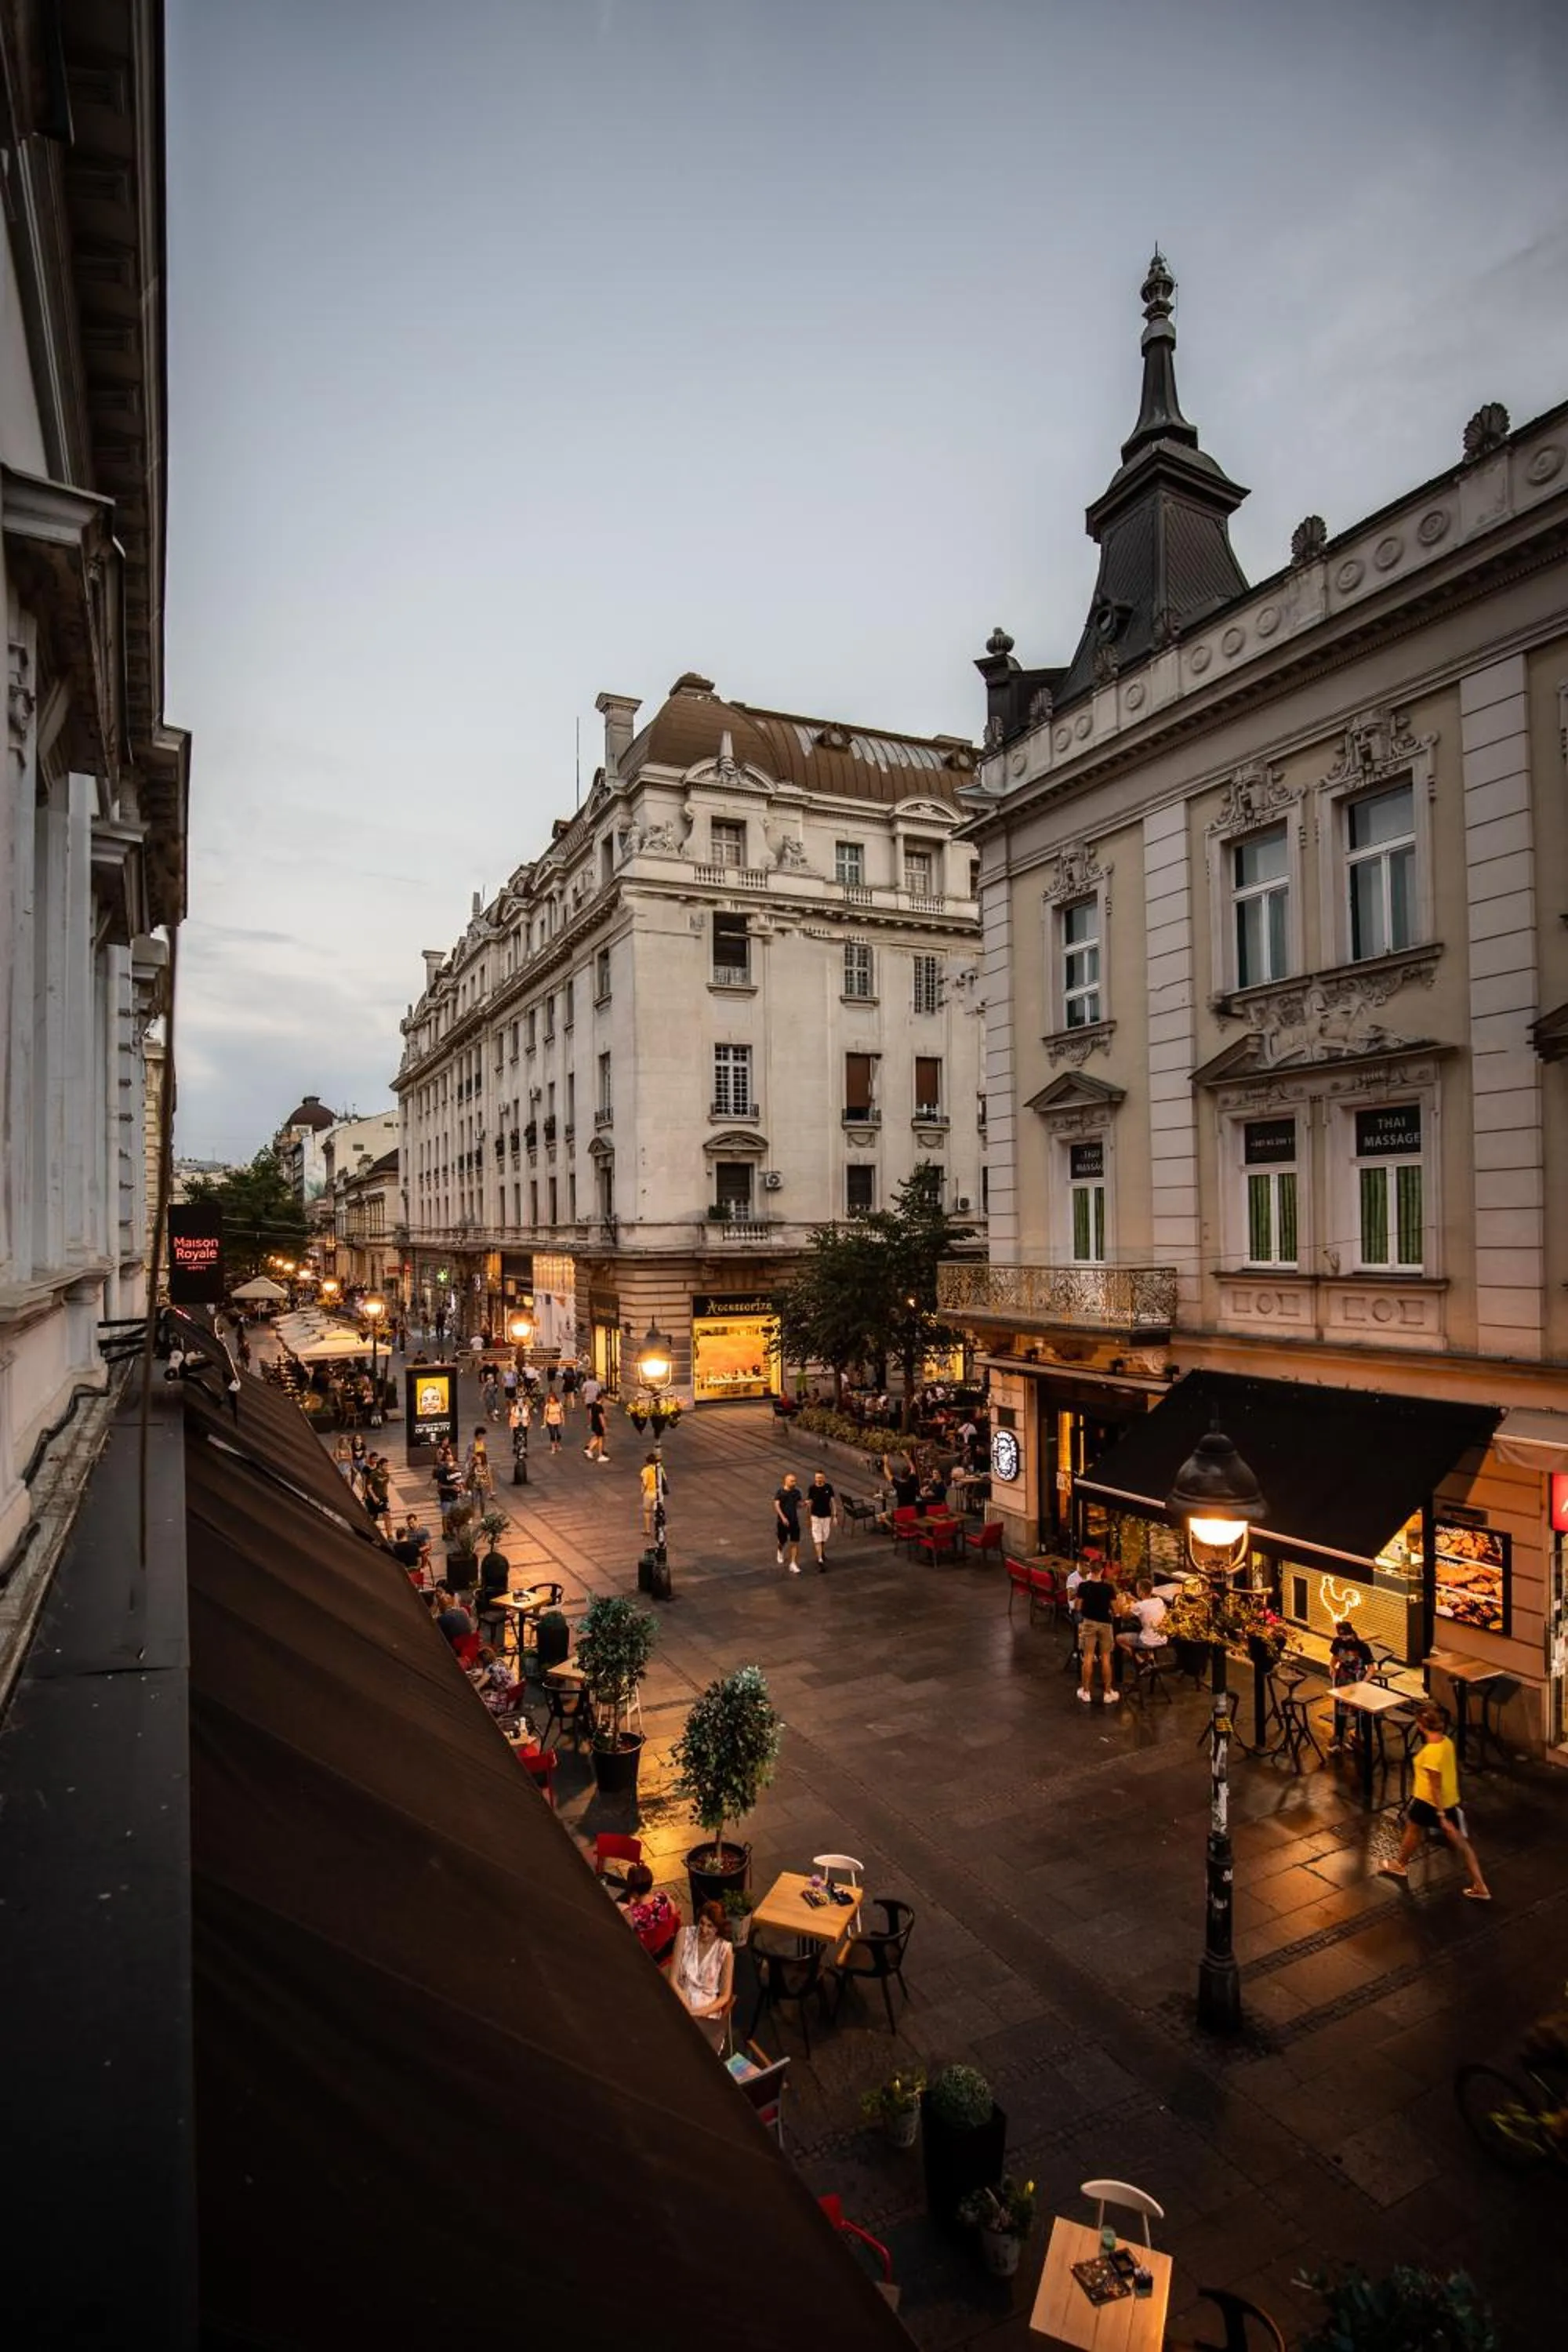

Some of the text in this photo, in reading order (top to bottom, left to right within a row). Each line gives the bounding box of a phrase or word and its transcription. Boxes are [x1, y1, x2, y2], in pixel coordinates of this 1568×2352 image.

[1377, 1116, 1406, 1129] THAI
[1363, 1131, 1421, 1148] MASSAGE
[173, 1236, 219, 1248] Maison
[176, 1247, 218, 1261] Royale
